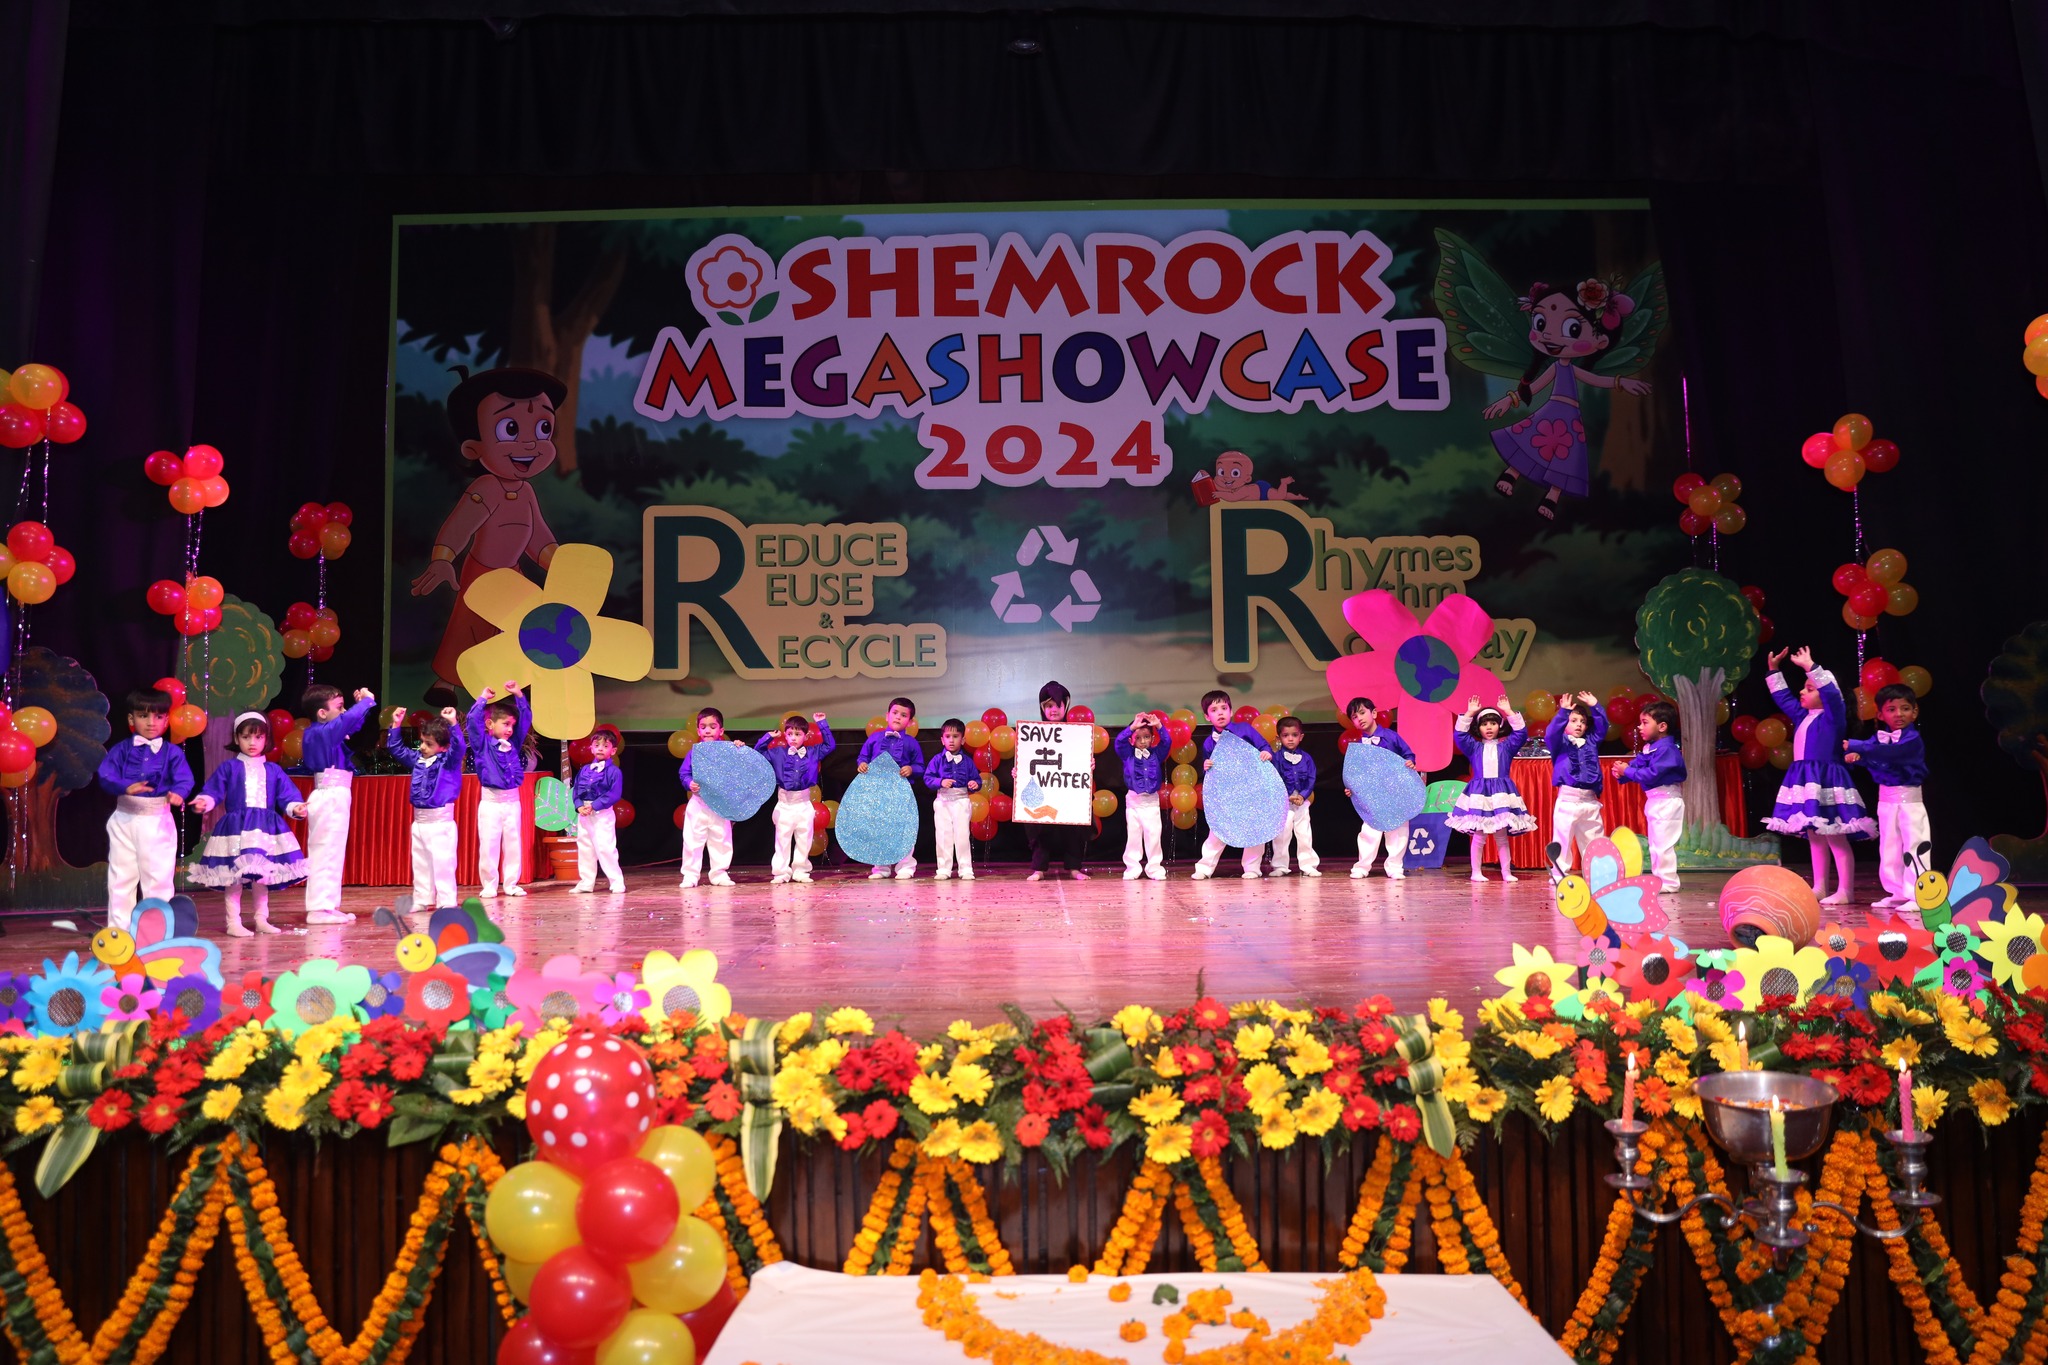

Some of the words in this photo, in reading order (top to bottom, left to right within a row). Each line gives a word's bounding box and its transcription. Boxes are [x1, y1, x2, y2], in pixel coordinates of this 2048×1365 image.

[787, 241, 1386, 321] SHEMROCK
[643, 329, 1440, 411] MEGASHOWCASE
[928, 419, 1162, 478] 2024
[818, 612, 834, 629] &
[1020, 725, 1063, 743] SAVE
[1036, 771, 1090, 789] WATER
